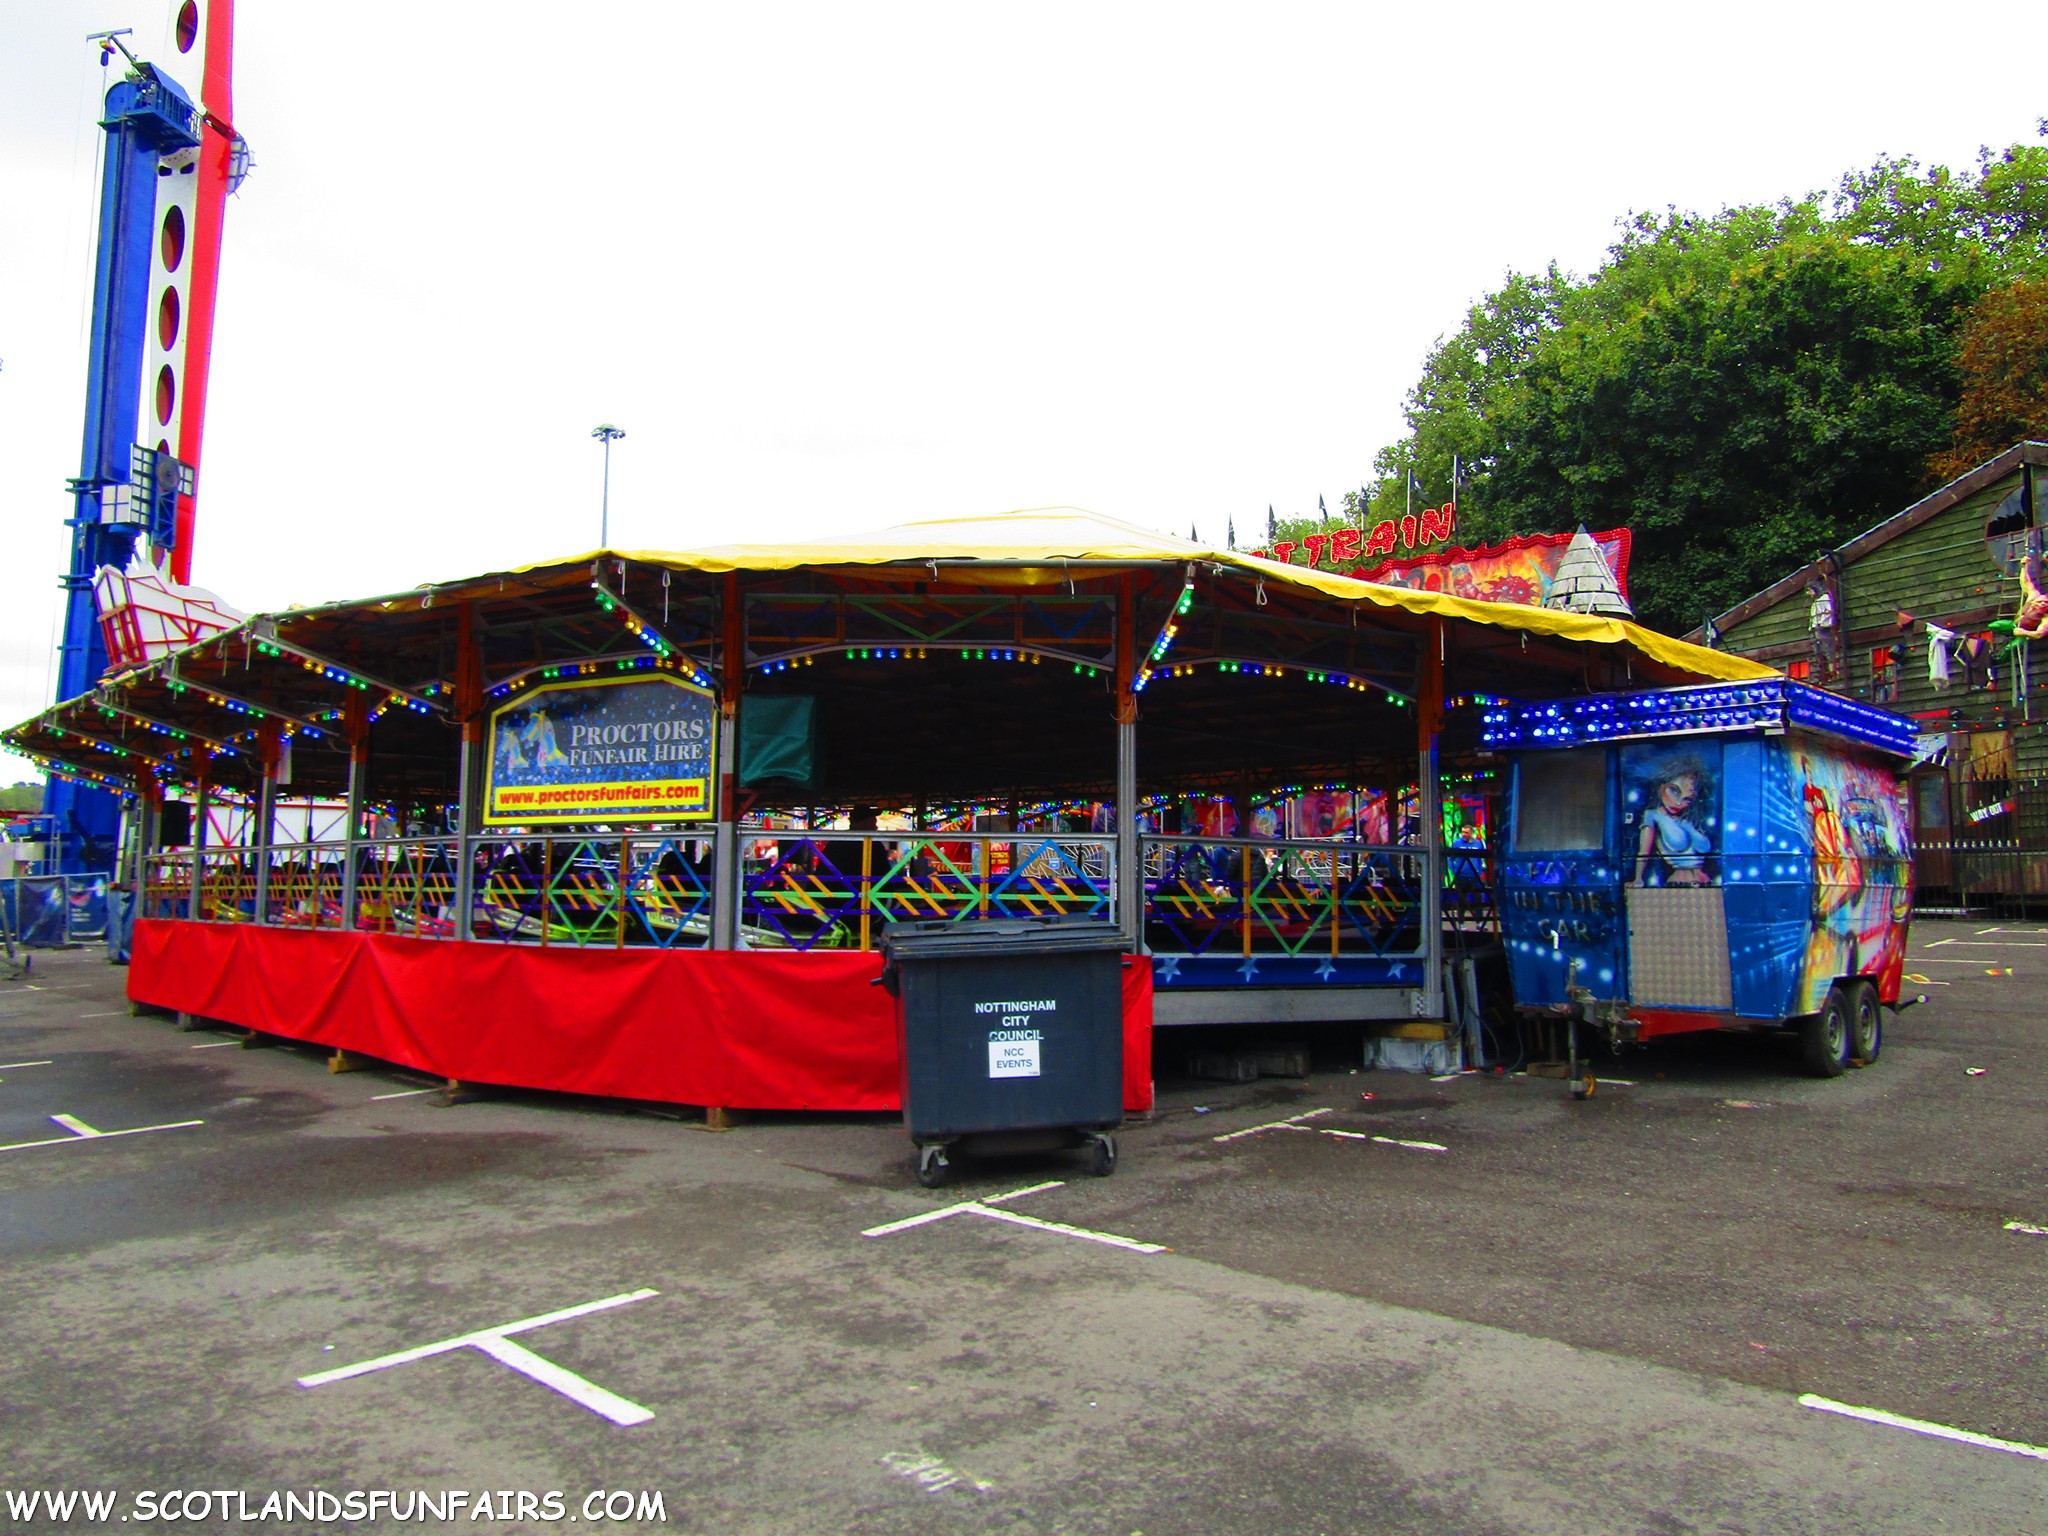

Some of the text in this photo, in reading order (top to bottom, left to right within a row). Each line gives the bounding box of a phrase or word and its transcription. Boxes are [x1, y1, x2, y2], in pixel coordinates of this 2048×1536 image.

[1303, 502, 1455, 568] TRAIN
[571, 718, 704, 748] PROCTORS
[570, 743, 703, 766] FUNFAIR HIRE
[500, 783, 699, 806] www.proctorsfunfairs.com
[1969, 802, 2002, 822] WAY OUT
[1548, 891, 1600, 913] THE
[1537, 918, 1590, 942] CAR
[975, 1000, 1055, 1013] NOTTINGHAM
[1002, 1015, 1030, 1027] CITY
[989, 1029, 1044, 1041] COUNCIL
[1004, 1047, 1024, 1057] NCC
[996, 1059, 1032, 1069] EVENTS
